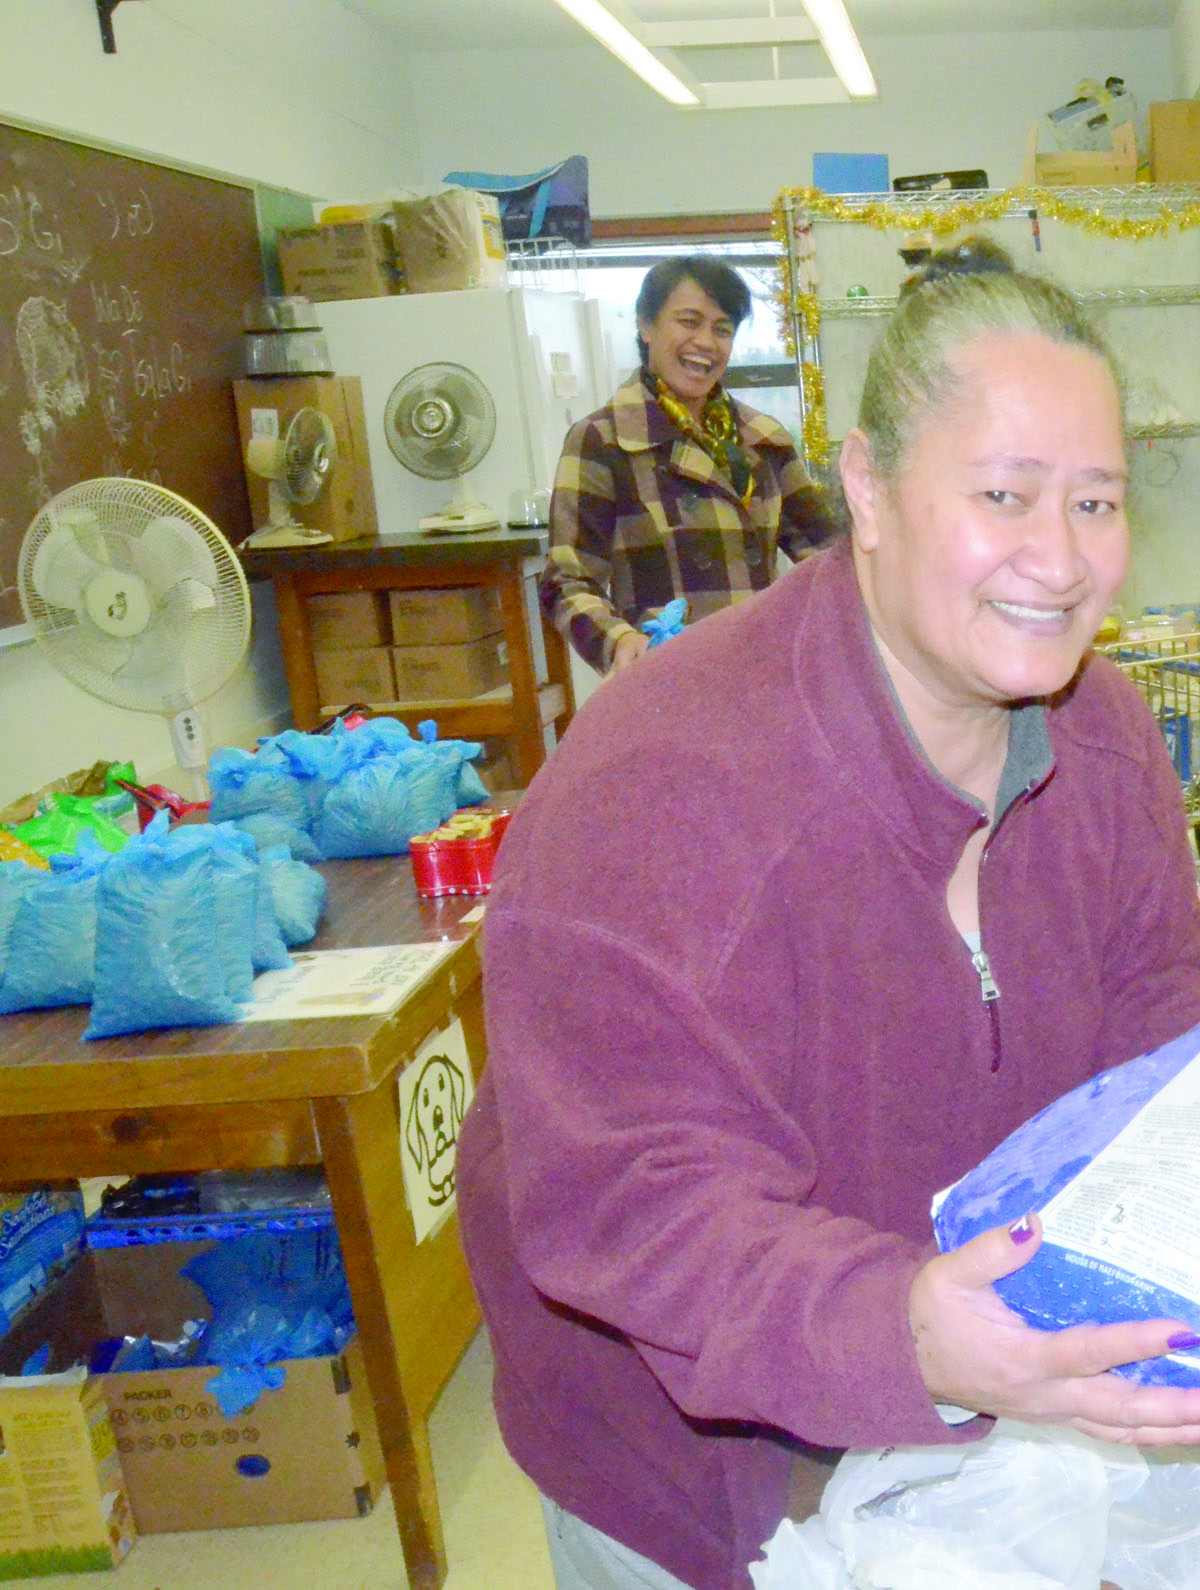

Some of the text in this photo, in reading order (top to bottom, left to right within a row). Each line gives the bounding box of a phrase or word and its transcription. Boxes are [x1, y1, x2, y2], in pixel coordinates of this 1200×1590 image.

[1065, 1252, 1089, 1268] HOUSE
[1088, 1260, 1099, 1271] OF
[123, 1388, 172, 1401] PACKER
